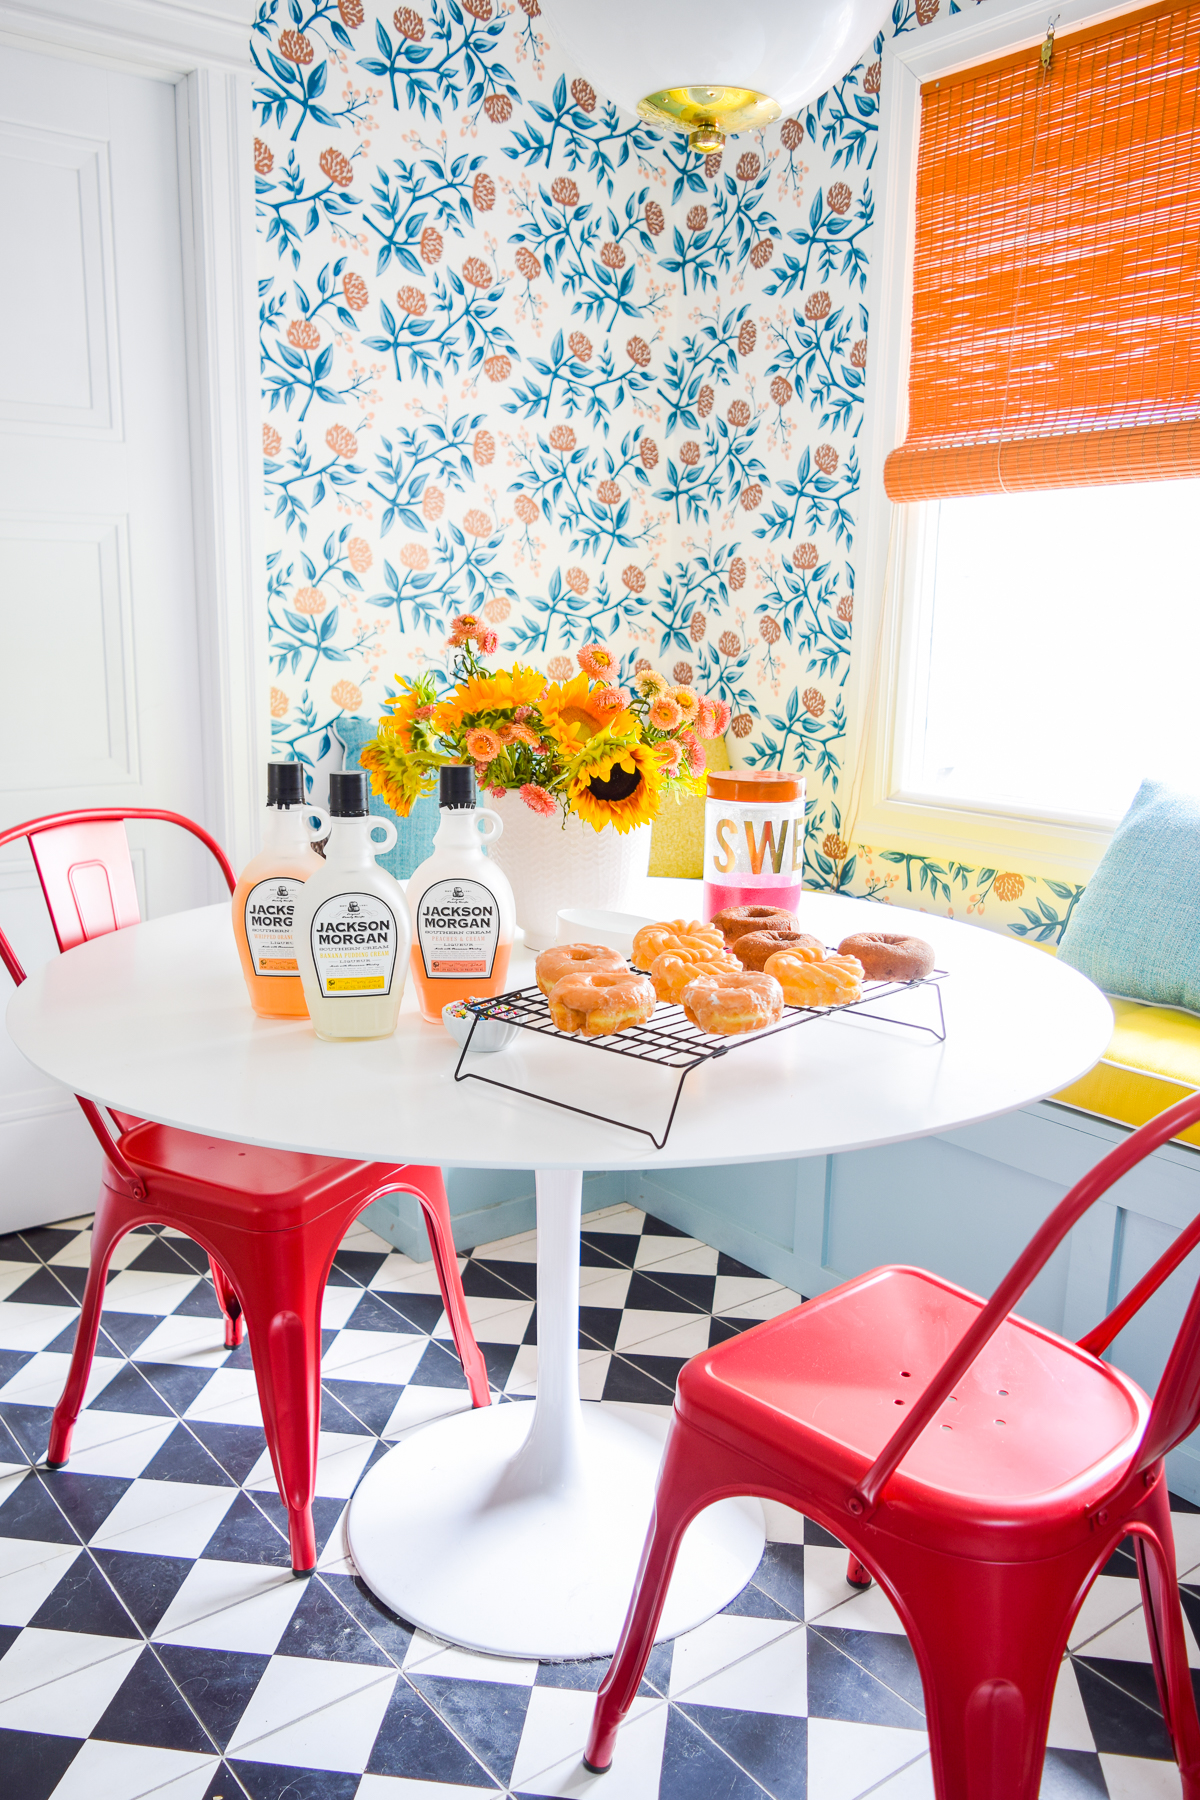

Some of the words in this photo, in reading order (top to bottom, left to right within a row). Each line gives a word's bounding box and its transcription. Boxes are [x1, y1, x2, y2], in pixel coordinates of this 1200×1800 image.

[713, 818, 803, 875] SWE
[249, 904, 295, 915] JACKS
[422, 906, 493, 917] JACKSON
[251, 916, 293, 927] MORG
[316, 920, 390, 933] JACKSON
[424, 917, 491, 929] MORGAN
[318, 932, 388, 945] MORGAN
